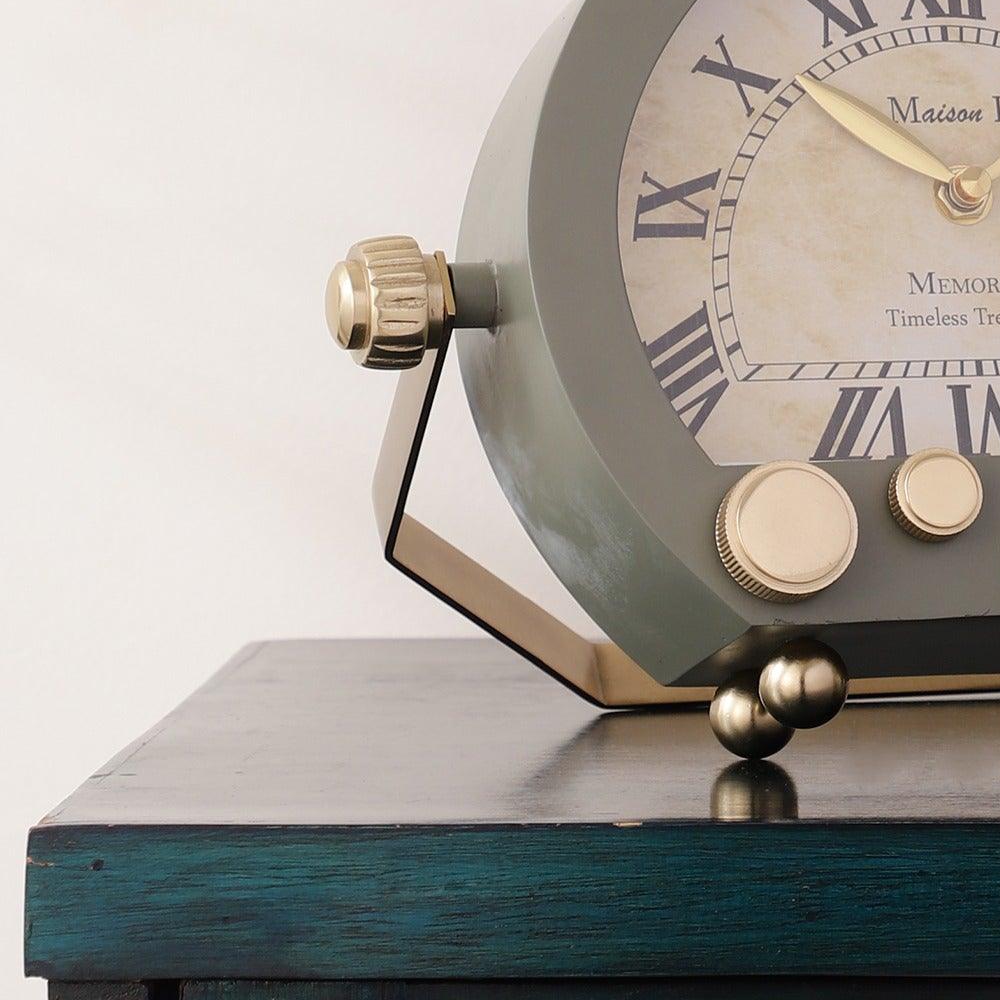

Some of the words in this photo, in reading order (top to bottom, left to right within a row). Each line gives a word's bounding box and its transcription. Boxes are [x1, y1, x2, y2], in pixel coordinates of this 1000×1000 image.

[692, 34, 781, 118] X
[886, 96, 983, 124] Maison
[633, 168, 722, 241] IX
[886, 307, 968, 327] Timeless
